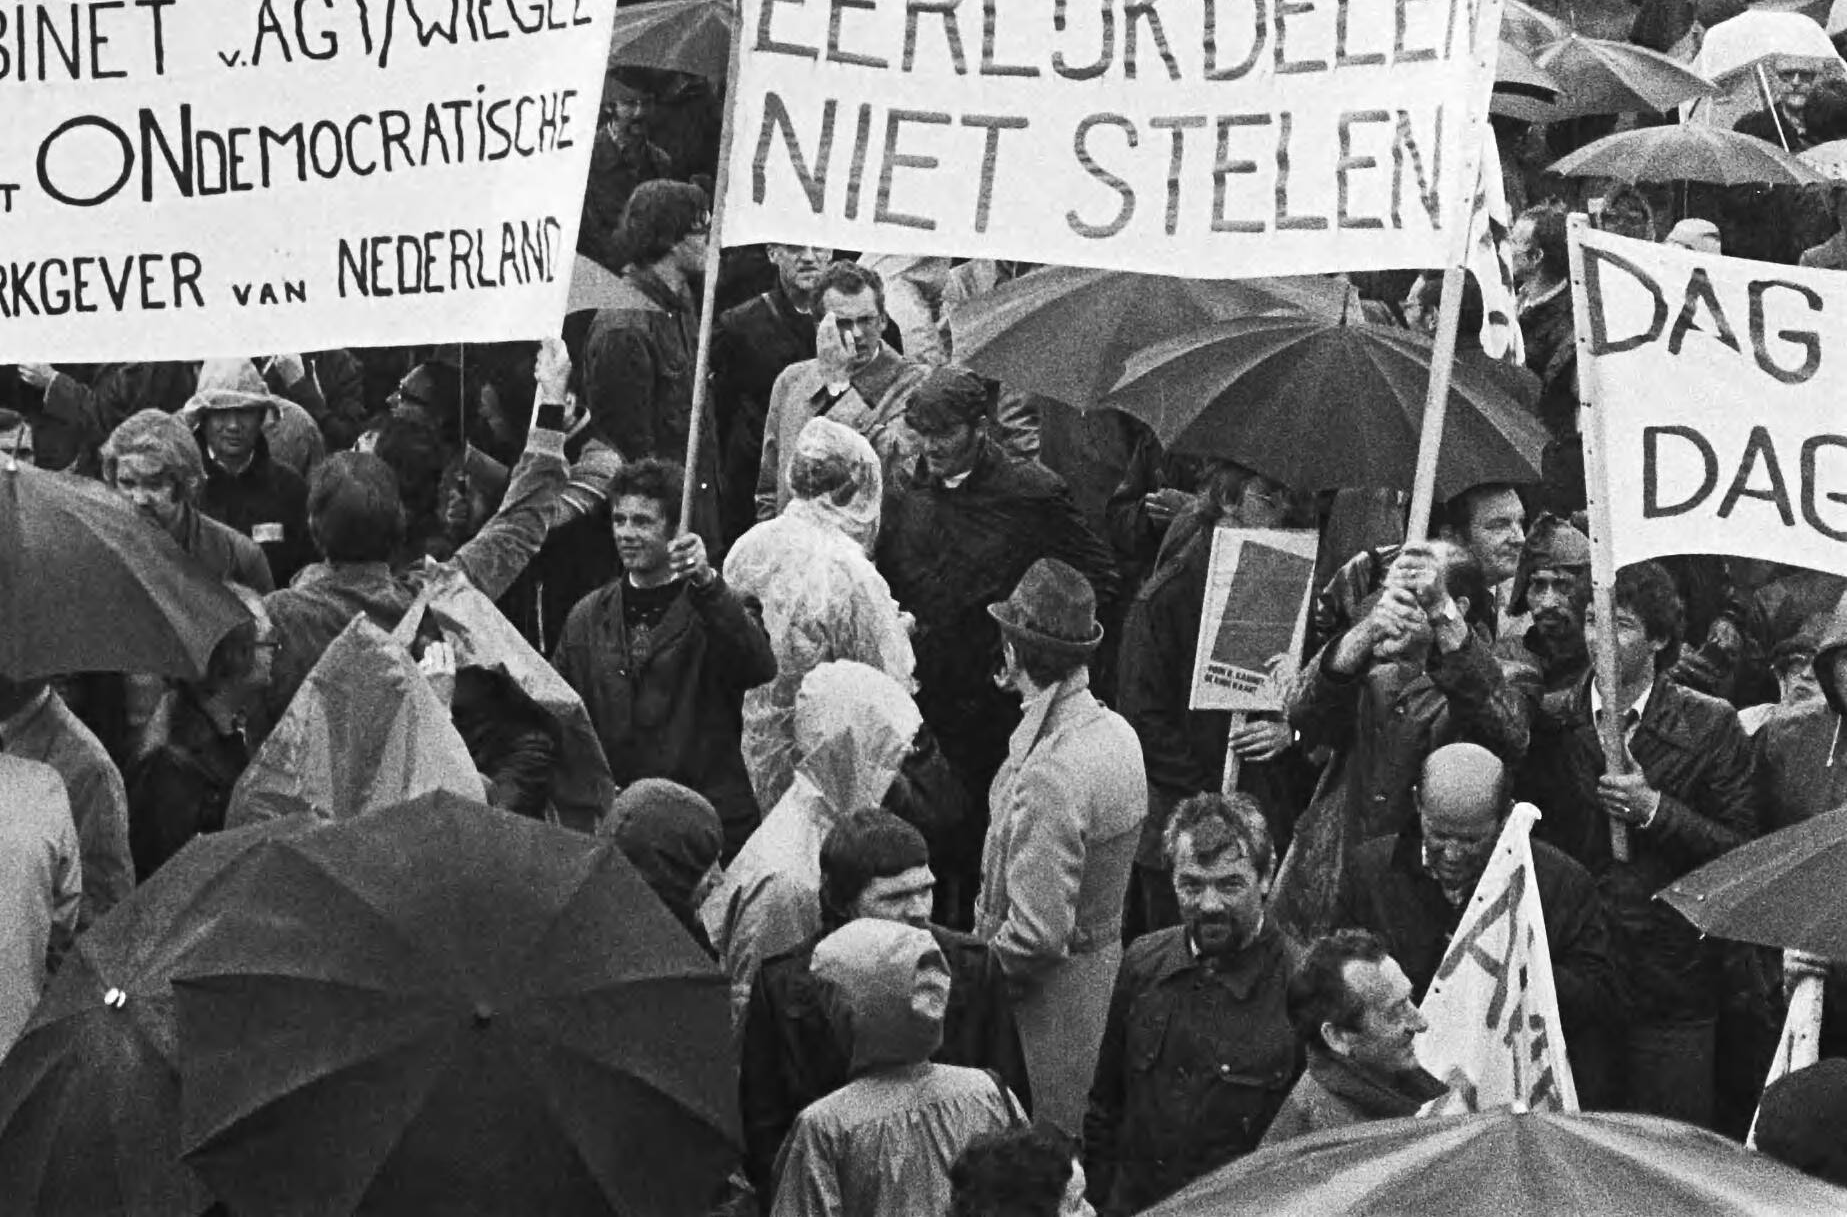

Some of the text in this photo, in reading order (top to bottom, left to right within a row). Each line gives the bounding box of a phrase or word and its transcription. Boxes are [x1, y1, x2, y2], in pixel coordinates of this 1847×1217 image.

[752, 92, 1444, 240] NIET STELEN
[338, 216, 562, 300] NEDERLAND
[1579, 243, 1824, 385] DAG
[1643, 425, 1847, 543] DAG
